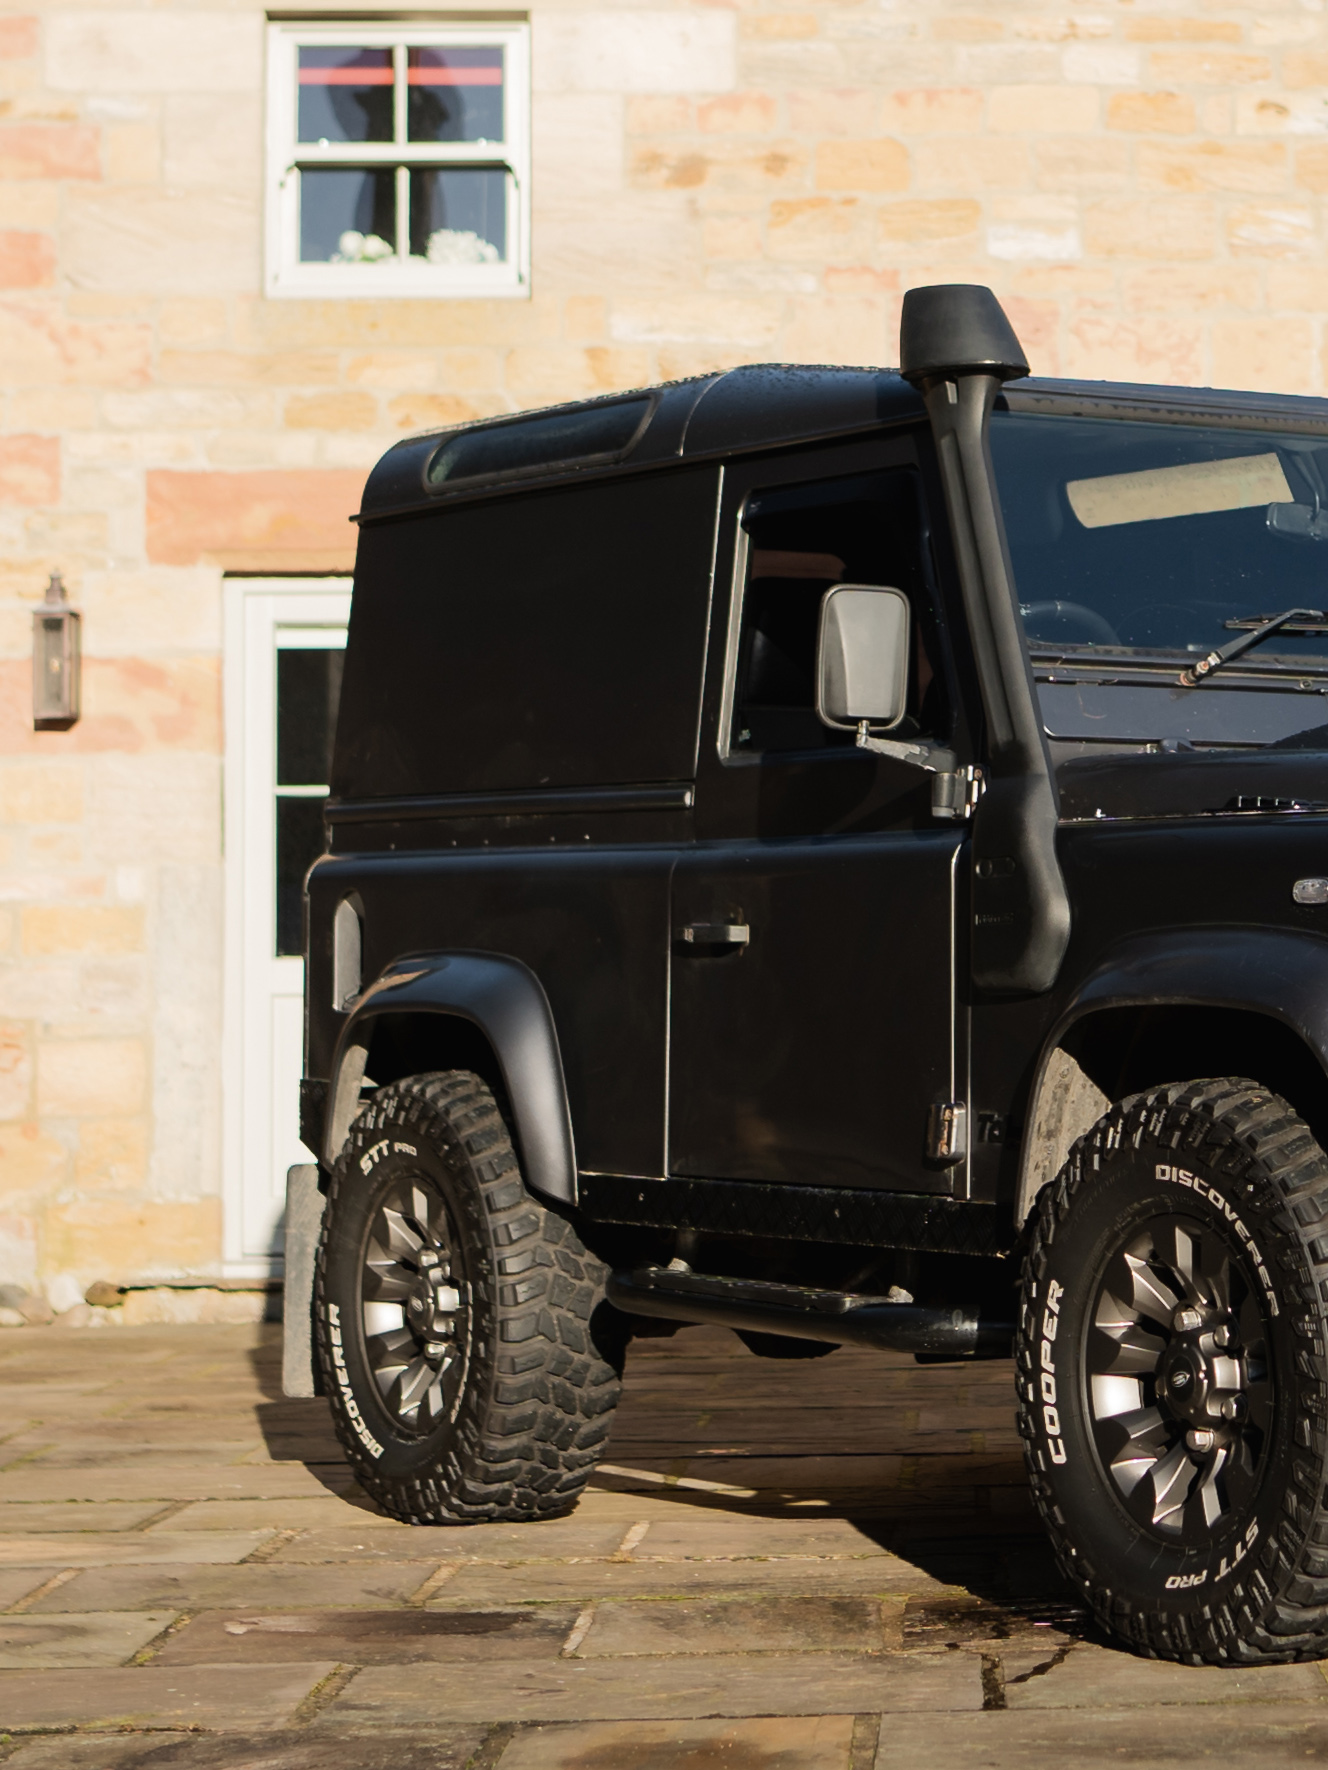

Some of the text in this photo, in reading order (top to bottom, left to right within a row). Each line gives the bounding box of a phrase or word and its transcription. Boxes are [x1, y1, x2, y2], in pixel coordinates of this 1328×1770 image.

[358, 1138, 418, 1177] STT PRO
[1154, 1163, 1280, 1319] DISCOVERER
[328, 1303, 385, 1460] DISCOVERER
[1039, 1278, 1068, 1465] COOPER
[1166, 1515, 1260, 1589] STT PRO
